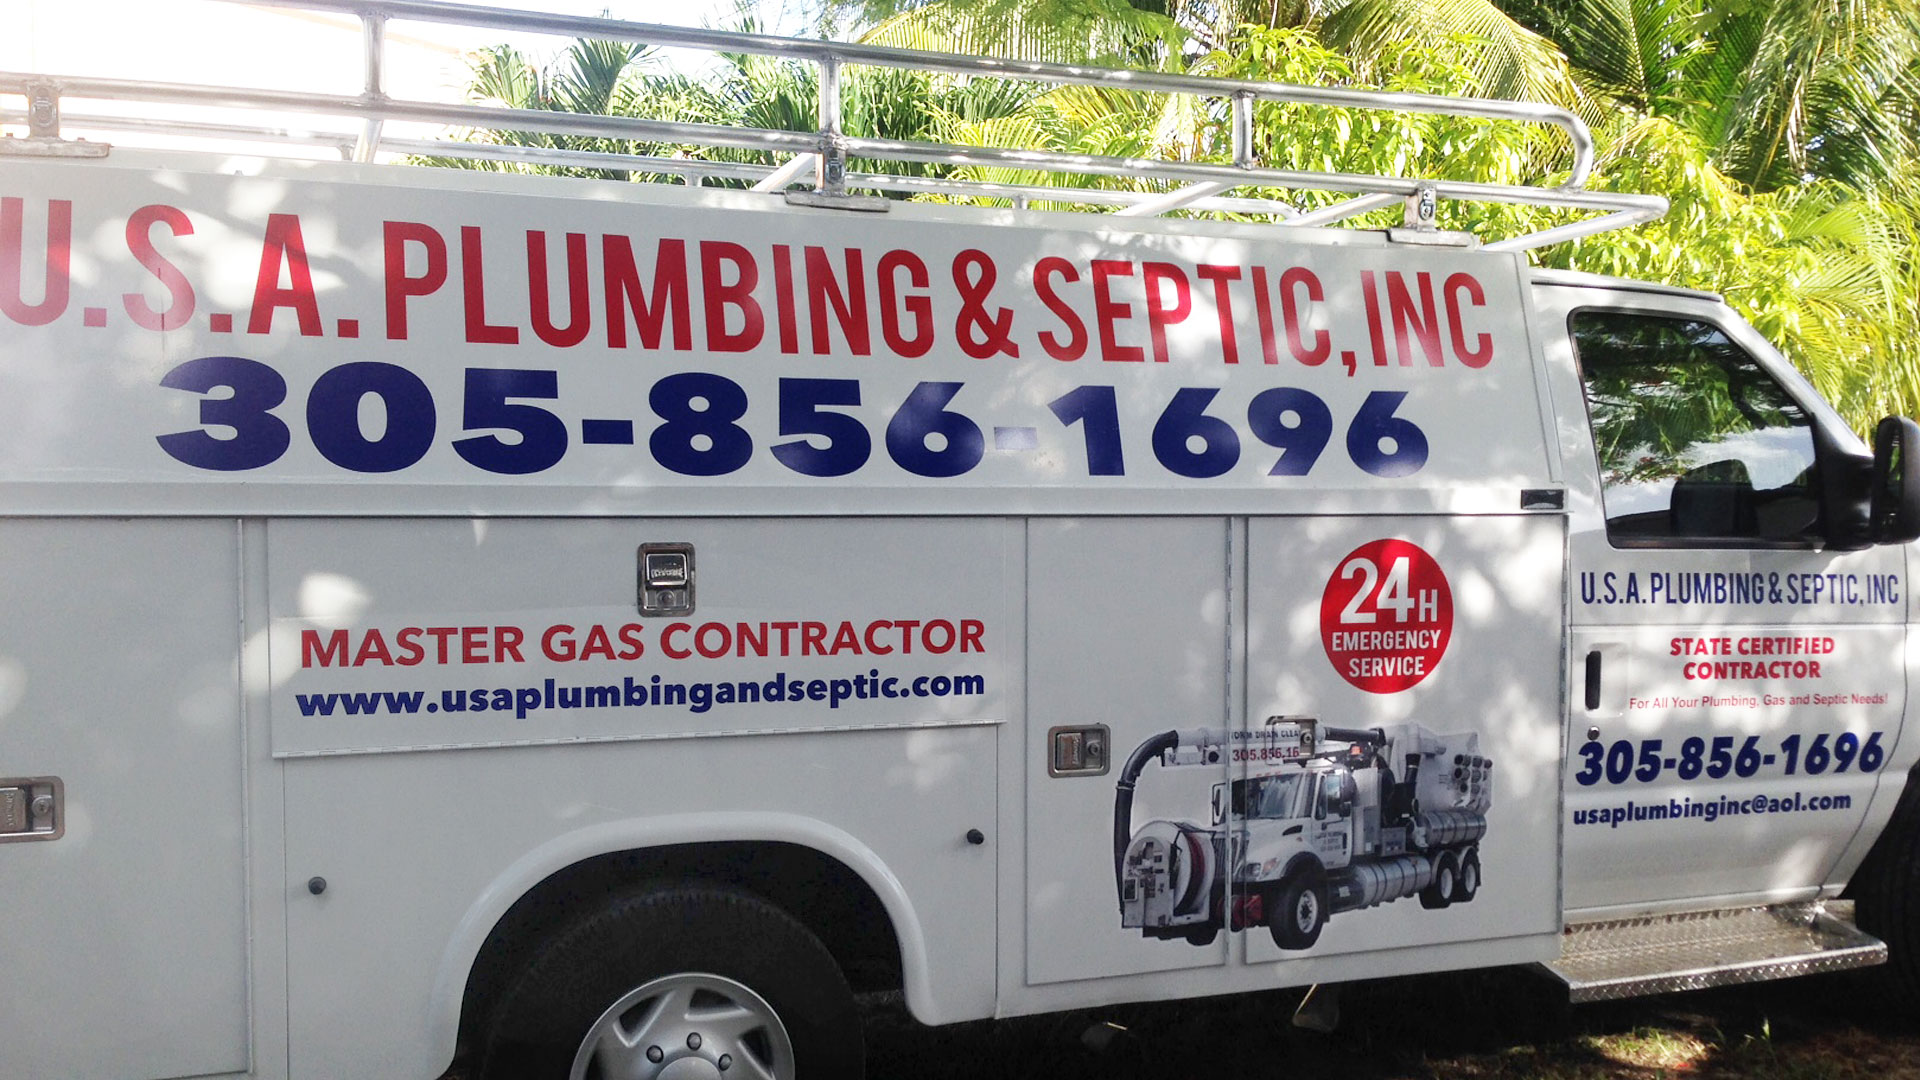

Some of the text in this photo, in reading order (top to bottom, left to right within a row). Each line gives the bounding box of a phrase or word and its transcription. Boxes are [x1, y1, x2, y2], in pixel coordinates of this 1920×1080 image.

[0, 196, 360, 339] U.S.A.
[382, 221, 936, 360] PLUMBING
[155, 355, 1430, 479] 305-856-1696
[1340, 557, 1438, 624] 24H
[1580, 571, 1647, 605] U.S.A.
[1650, 572, 1765, 605] PLUMBING
[301, 619, 986, 669] MASTER GAS CONTRACTOR
[1331, 629, 1442, 652] EMERGENCY
[1669, 636, 1836, 657] STATE CERTIFIED
[1348, 656, 1425, 678] SERVICE
[1682, 660, 1822, 681] CONTRACTOR
[295, 668, 985, 719] www.usaplumbingandseptic.com
[1629, 697, 1651, 710] For
[1652, 697, 1669, 709] All
[1671, 696, 1699, 708] Your
[1763, 694, 1786, 706] Gas
[1788, 693, 1811, 705] and
[1812, 692, 1849, 707] Septic
[1850, 692, 1889, 705] Needs!
[1576, 732, 1885, 785] 305-856-1696
[1573, 793, 1852, 828] usaplumbinginc@aol.com
